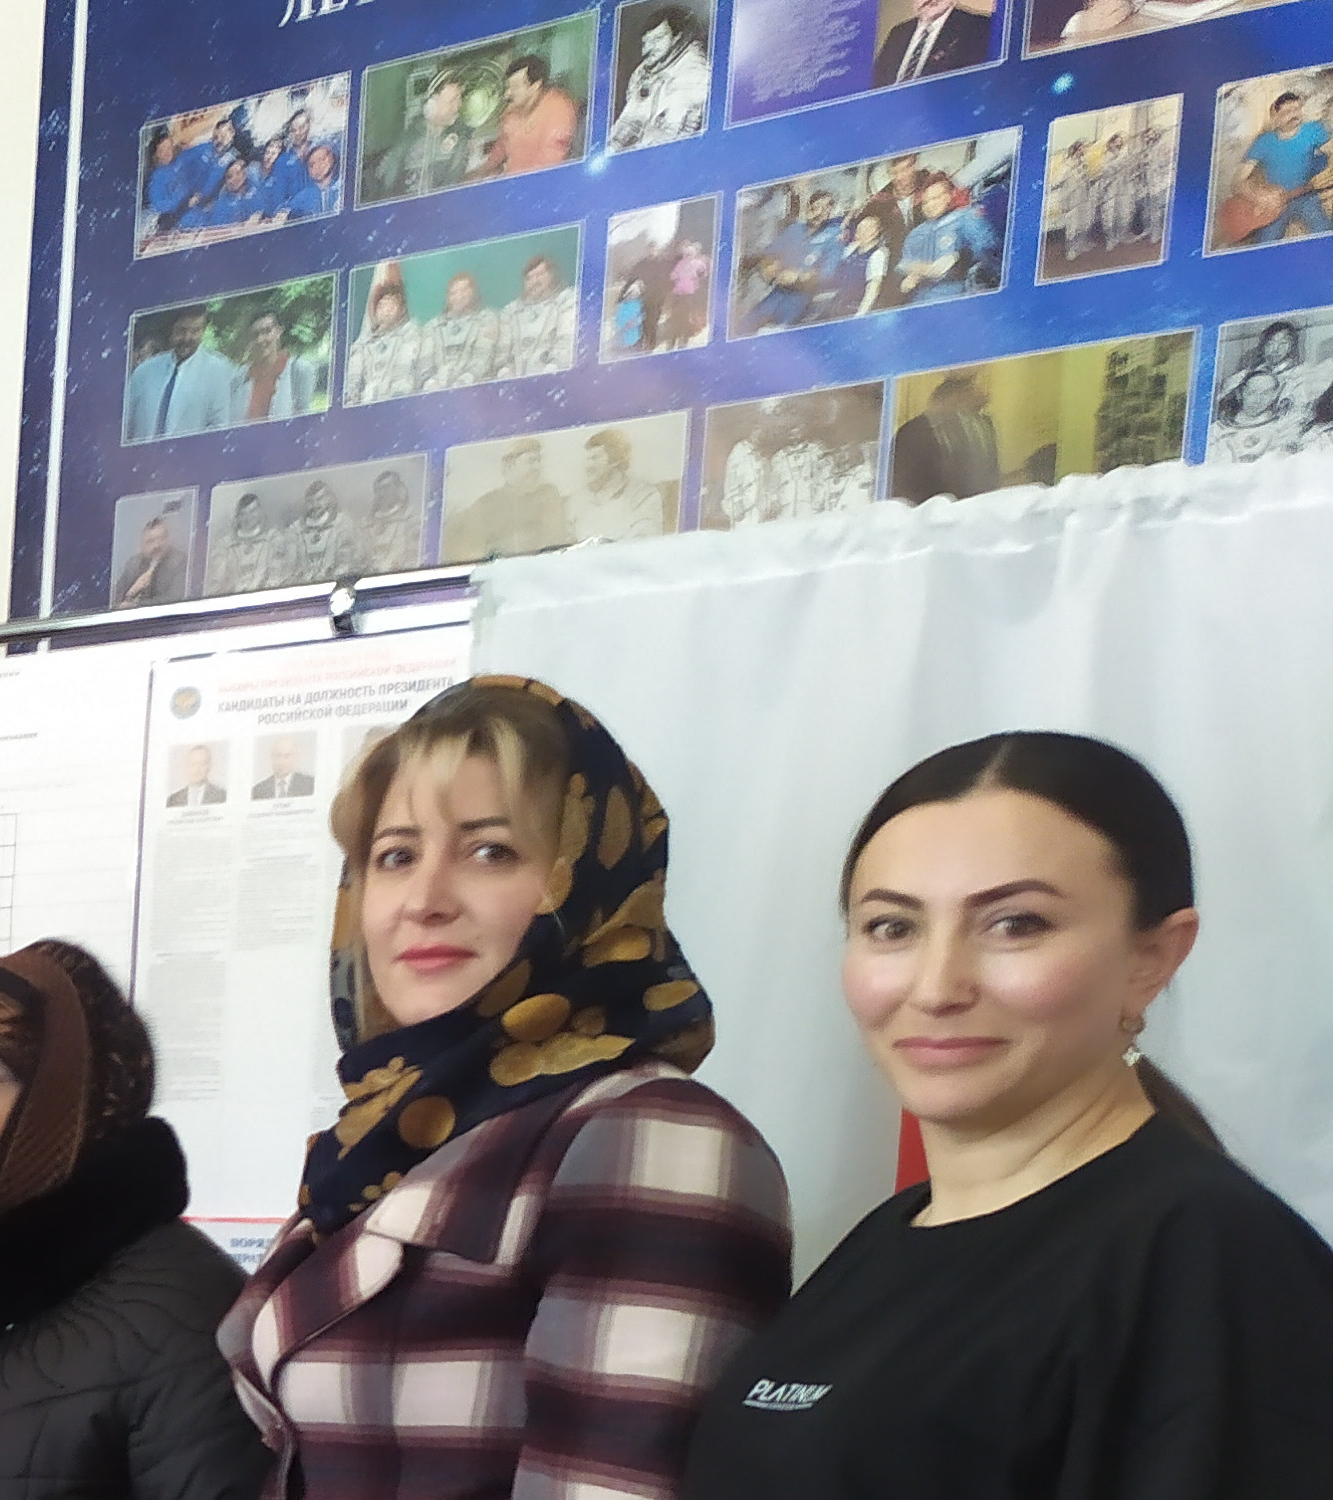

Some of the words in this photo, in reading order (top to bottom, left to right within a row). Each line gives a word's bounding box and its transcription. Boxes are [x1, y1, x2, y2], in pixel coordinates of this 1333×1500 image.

[217, 695, 285, 713] КАНДИДАТЫ
[287, 693, 302, 706] НА
[304, 685, 375, 705] ДОЛЖНОСТЬ
[378, 676, 454, 696] ПРЕЗИДЕНТА
[258, 704, 332, 725] РОССИЙСКОЙ
[335, 698, 408, 718] ФЕДЕРАЦИИ
